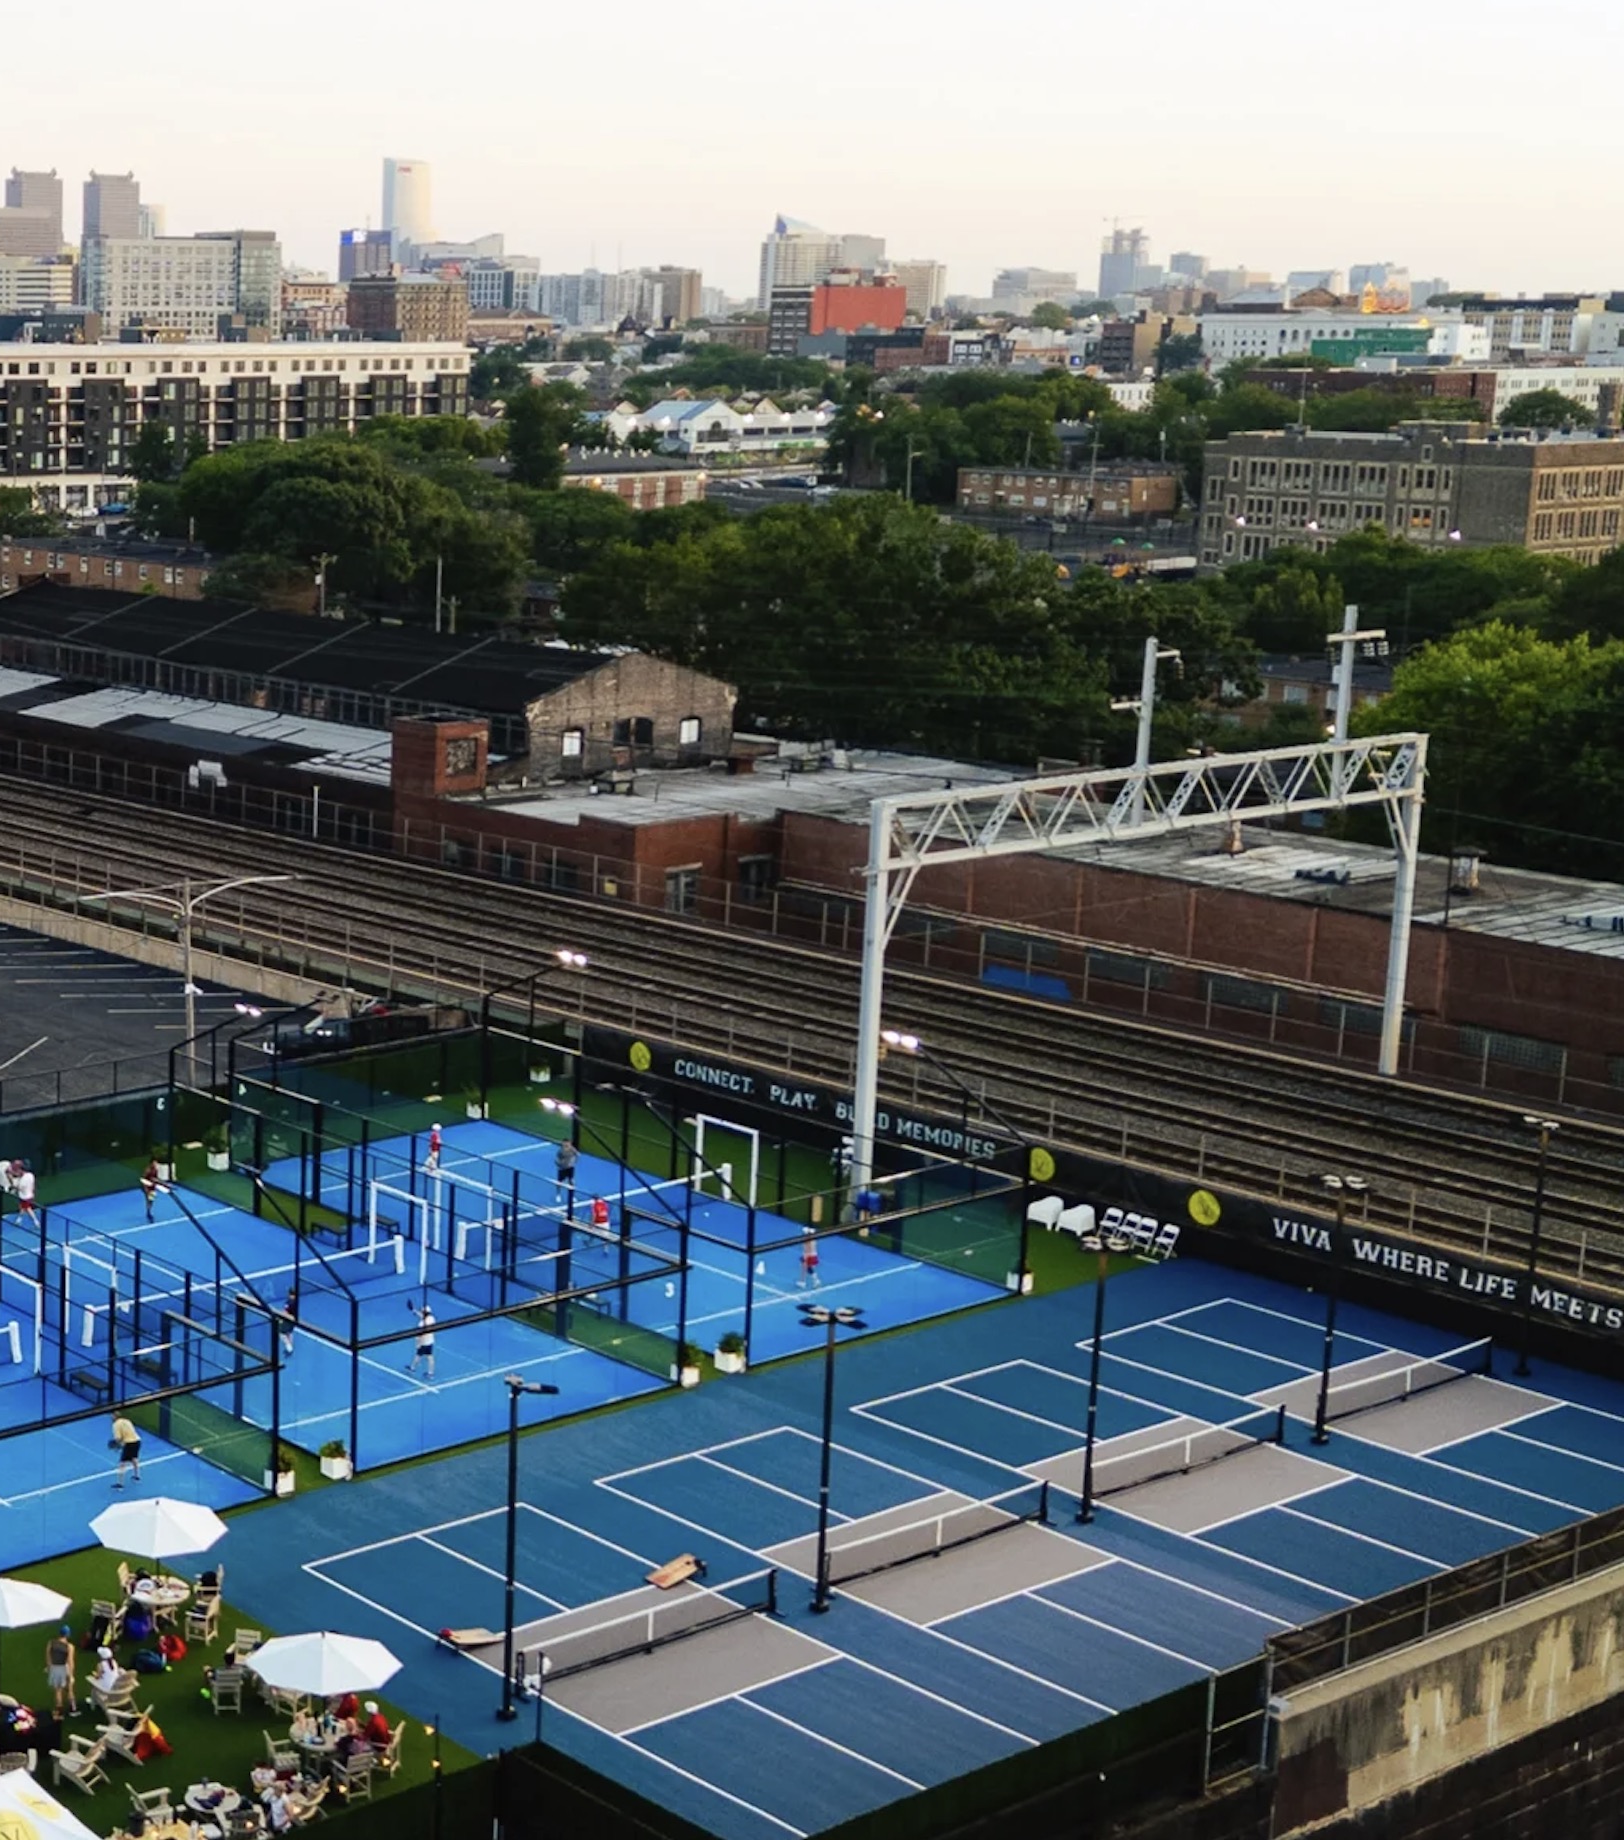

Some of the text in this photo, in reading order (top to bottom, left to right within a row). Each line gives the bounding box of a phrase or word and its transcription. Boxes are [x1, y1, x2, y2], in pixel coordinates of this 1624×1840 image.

[897, 1118, 996, 1160] MEMORIES
[1273, 1217, 1624, 1330] VIVA WHERE LIFE MEETS
